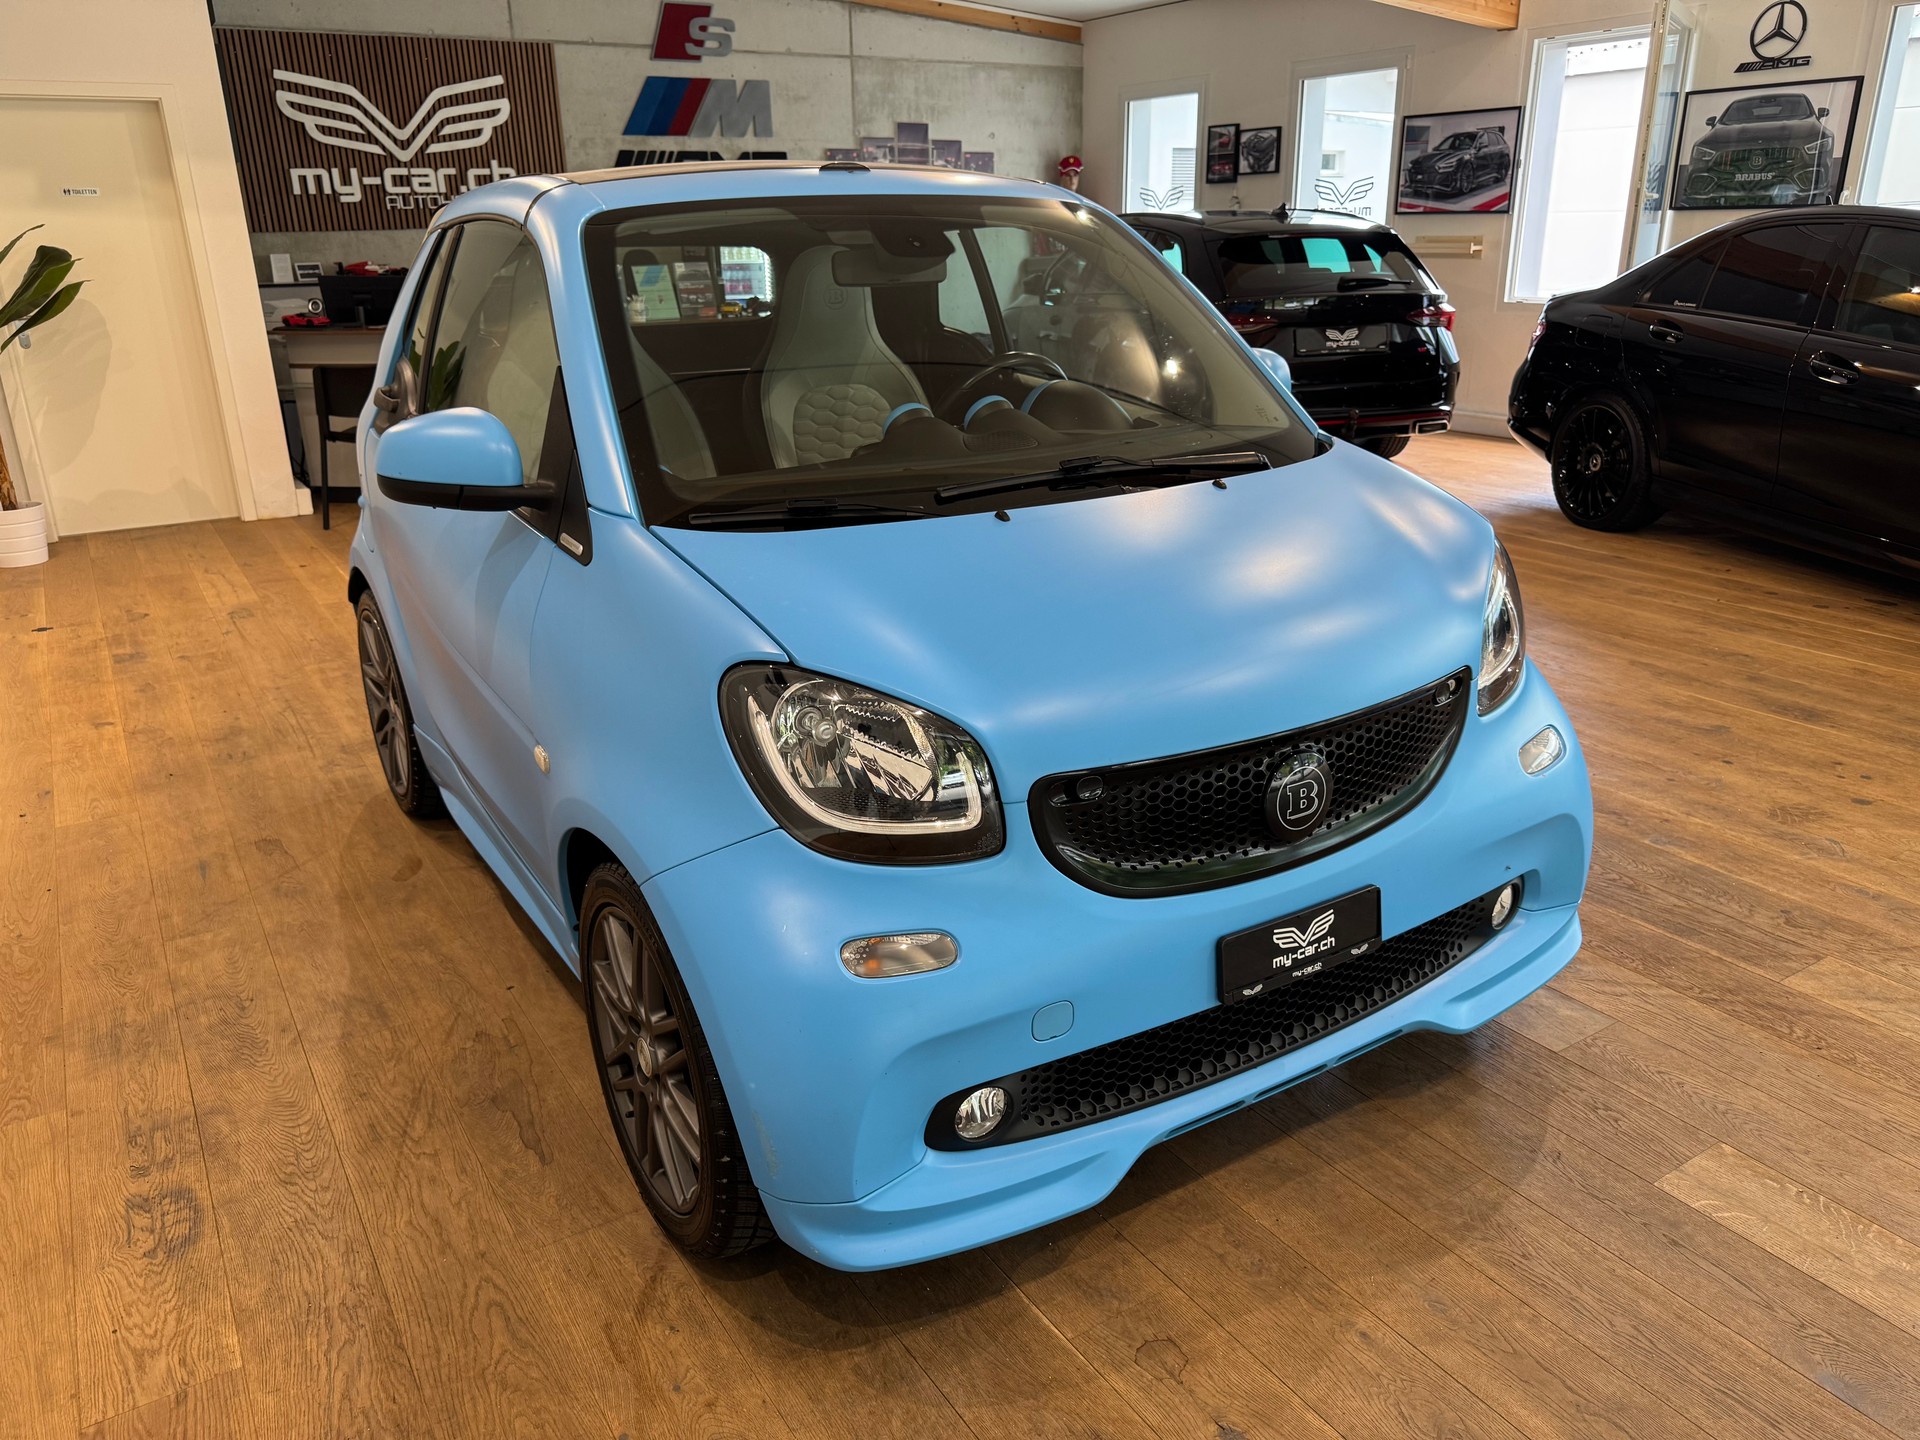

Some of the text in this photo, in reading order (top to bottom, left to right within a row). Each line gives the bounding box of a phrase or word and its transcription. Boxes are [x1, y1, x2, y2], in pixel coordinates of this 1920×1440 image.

[684, 16, 737, 58] S
[1758, 56, 1811, 71] AMG
[687, 78, 774, 138] M
[289, 159, 517, 203] my-car.ch
[1734, 172, 1774, 182] BRABUS
[1286, 779, 1319, 820] B
[1272, 935, 1336, 969] my-car.ch
[1292, 961, 1323, 977] my-car.ch
